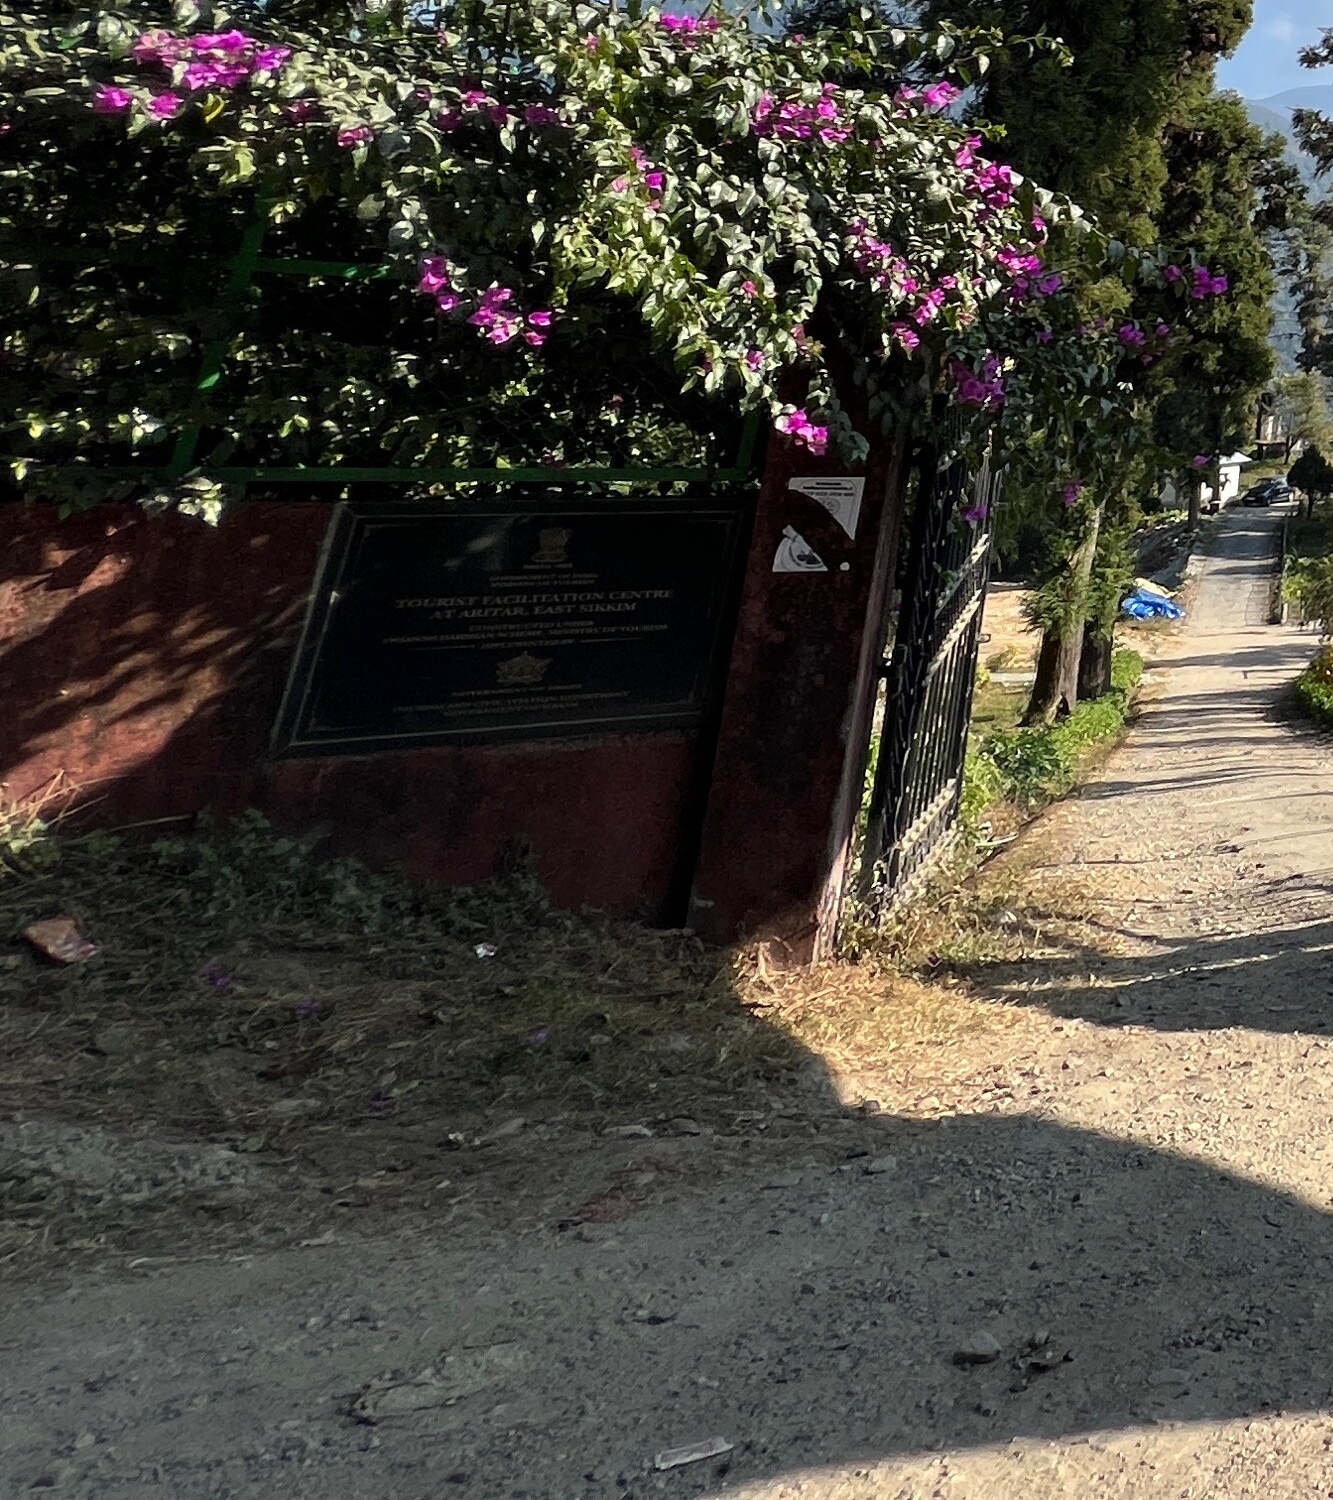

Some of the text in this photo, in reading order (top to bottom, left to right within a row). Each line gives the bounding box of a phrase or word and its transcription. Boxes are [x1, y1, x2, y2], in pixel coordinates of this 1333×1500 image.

[395, 589, 673, 609] TOURIST FACILITATION CENTRE
[430, 609, 457, 619] AT
[533, 604, 577, 614] EAST
[579, 602, 638, 612] SIKKIM
